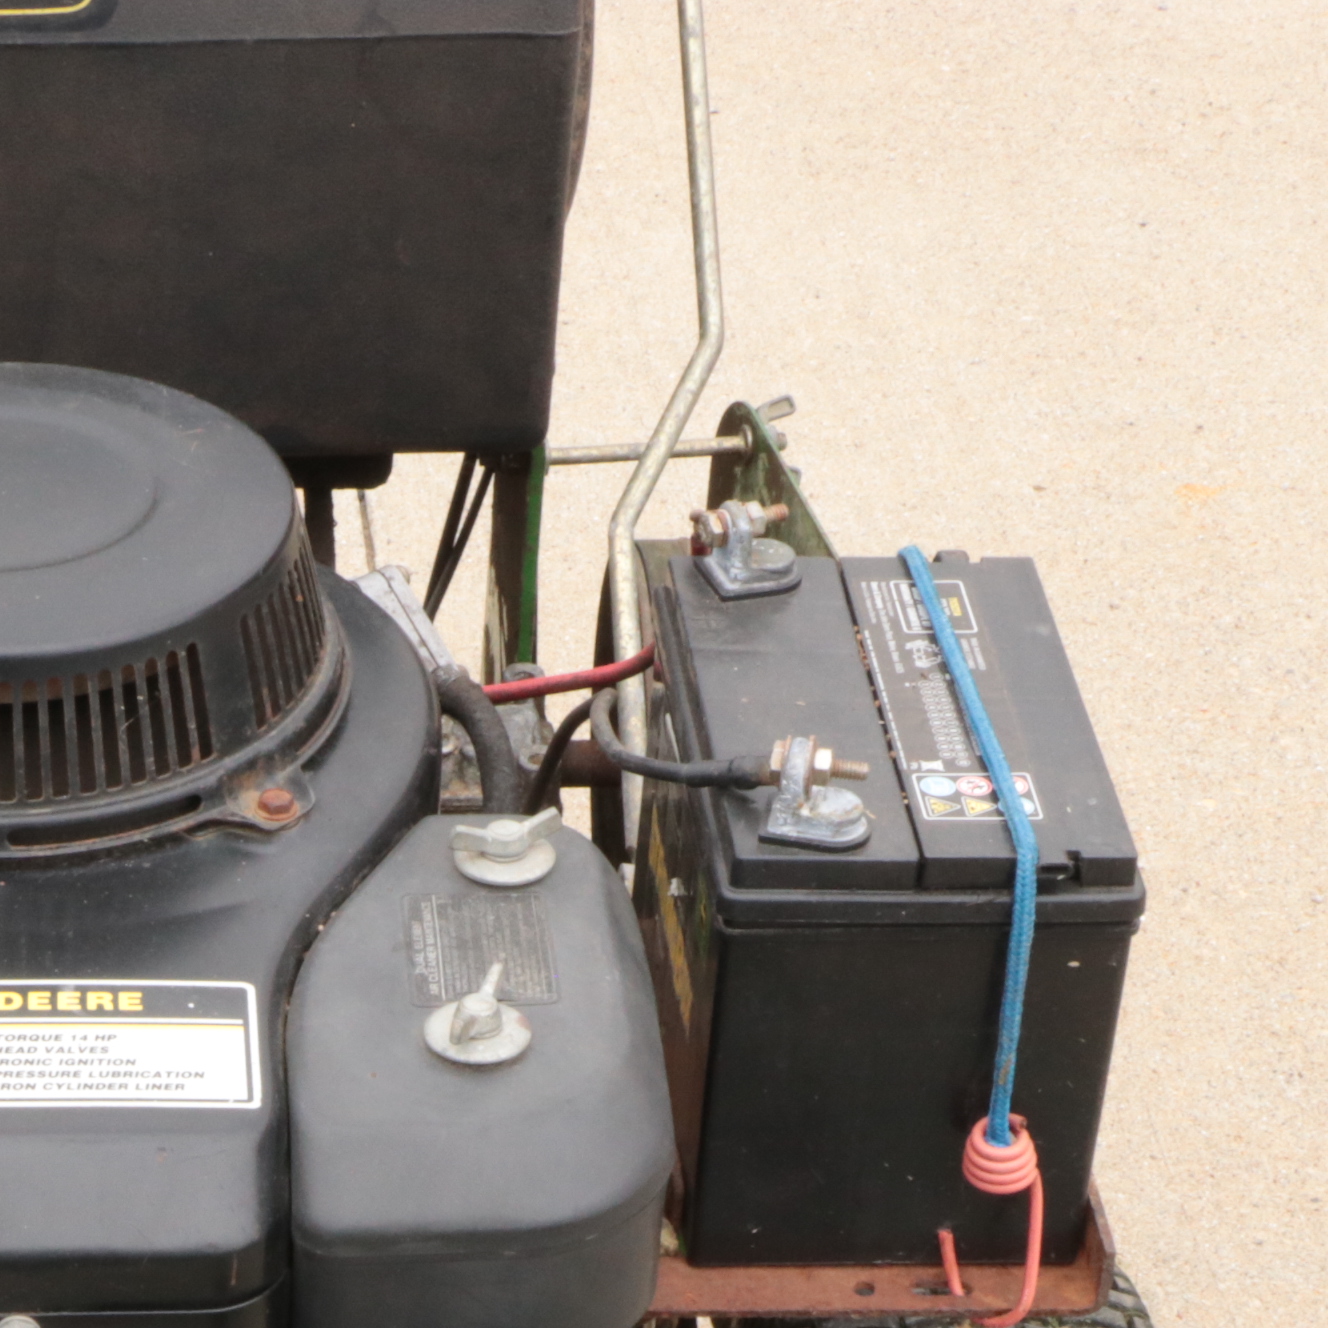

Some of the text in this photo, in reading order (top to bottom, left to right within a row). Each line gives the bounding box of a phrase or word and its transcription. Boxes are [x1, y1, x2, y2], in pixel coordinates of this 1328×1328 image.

[426, 946, 438, 982] CLEANER
[71, 1034, 88, 1042] 14
[95, 1034, 117, 1042] HP
[44, 1046, 109, 1054] VALVES
[59, 1058, 137, 1066] IGNITION
[89, 1070, 205, 1079] LUBRICATION
[43, 1083, 129, 1091] CYLINDER
[135, 1083, 185, 1091] LINER
